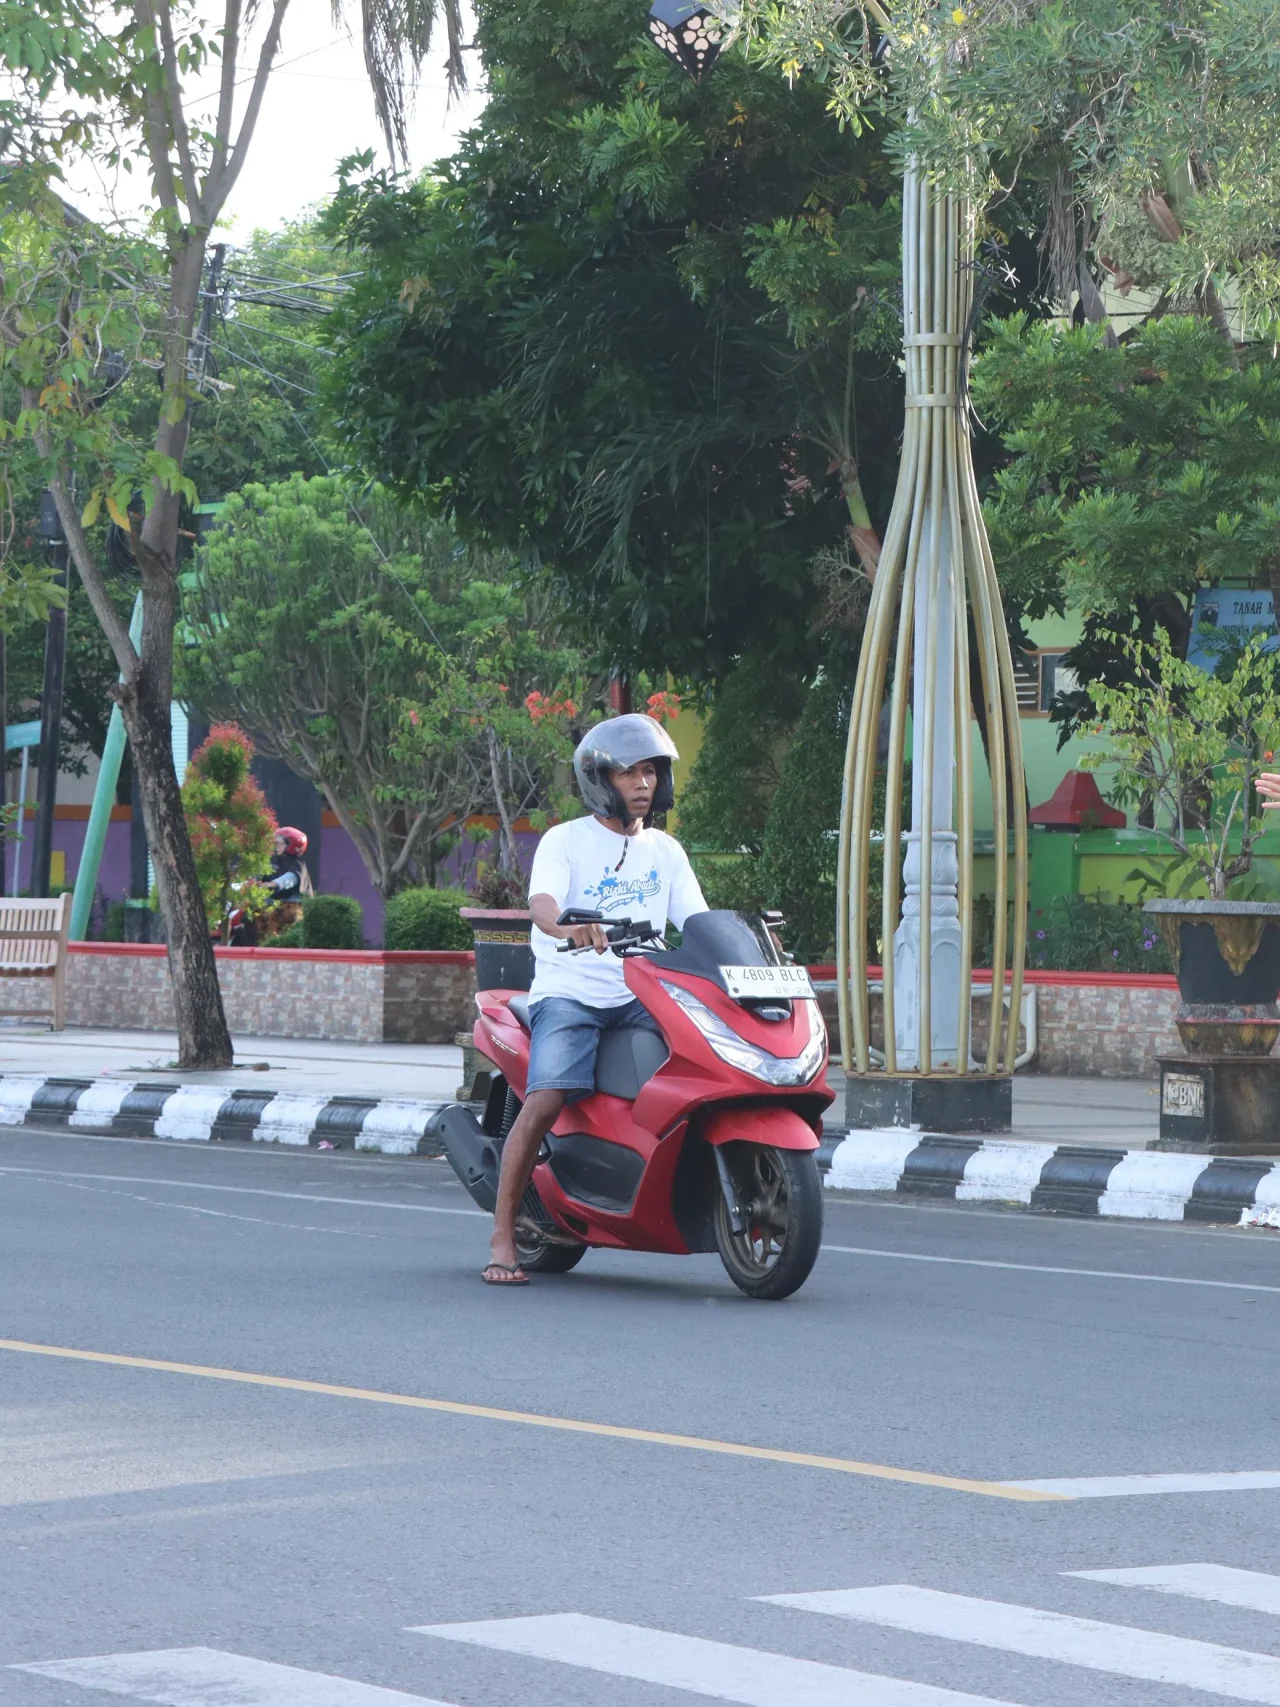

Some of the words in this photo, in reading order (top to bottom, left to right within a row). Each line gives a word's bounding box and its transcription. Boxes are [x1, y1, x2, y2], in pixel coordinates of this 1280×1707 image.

[1233, 601, 1263, 615] TANAH
[725, 968, 735, 981] K
[743, 968, 775, 981] 4809
[779, 968, 806, 981] BLC
[1179, 1085, 1201, 1105] BNI
